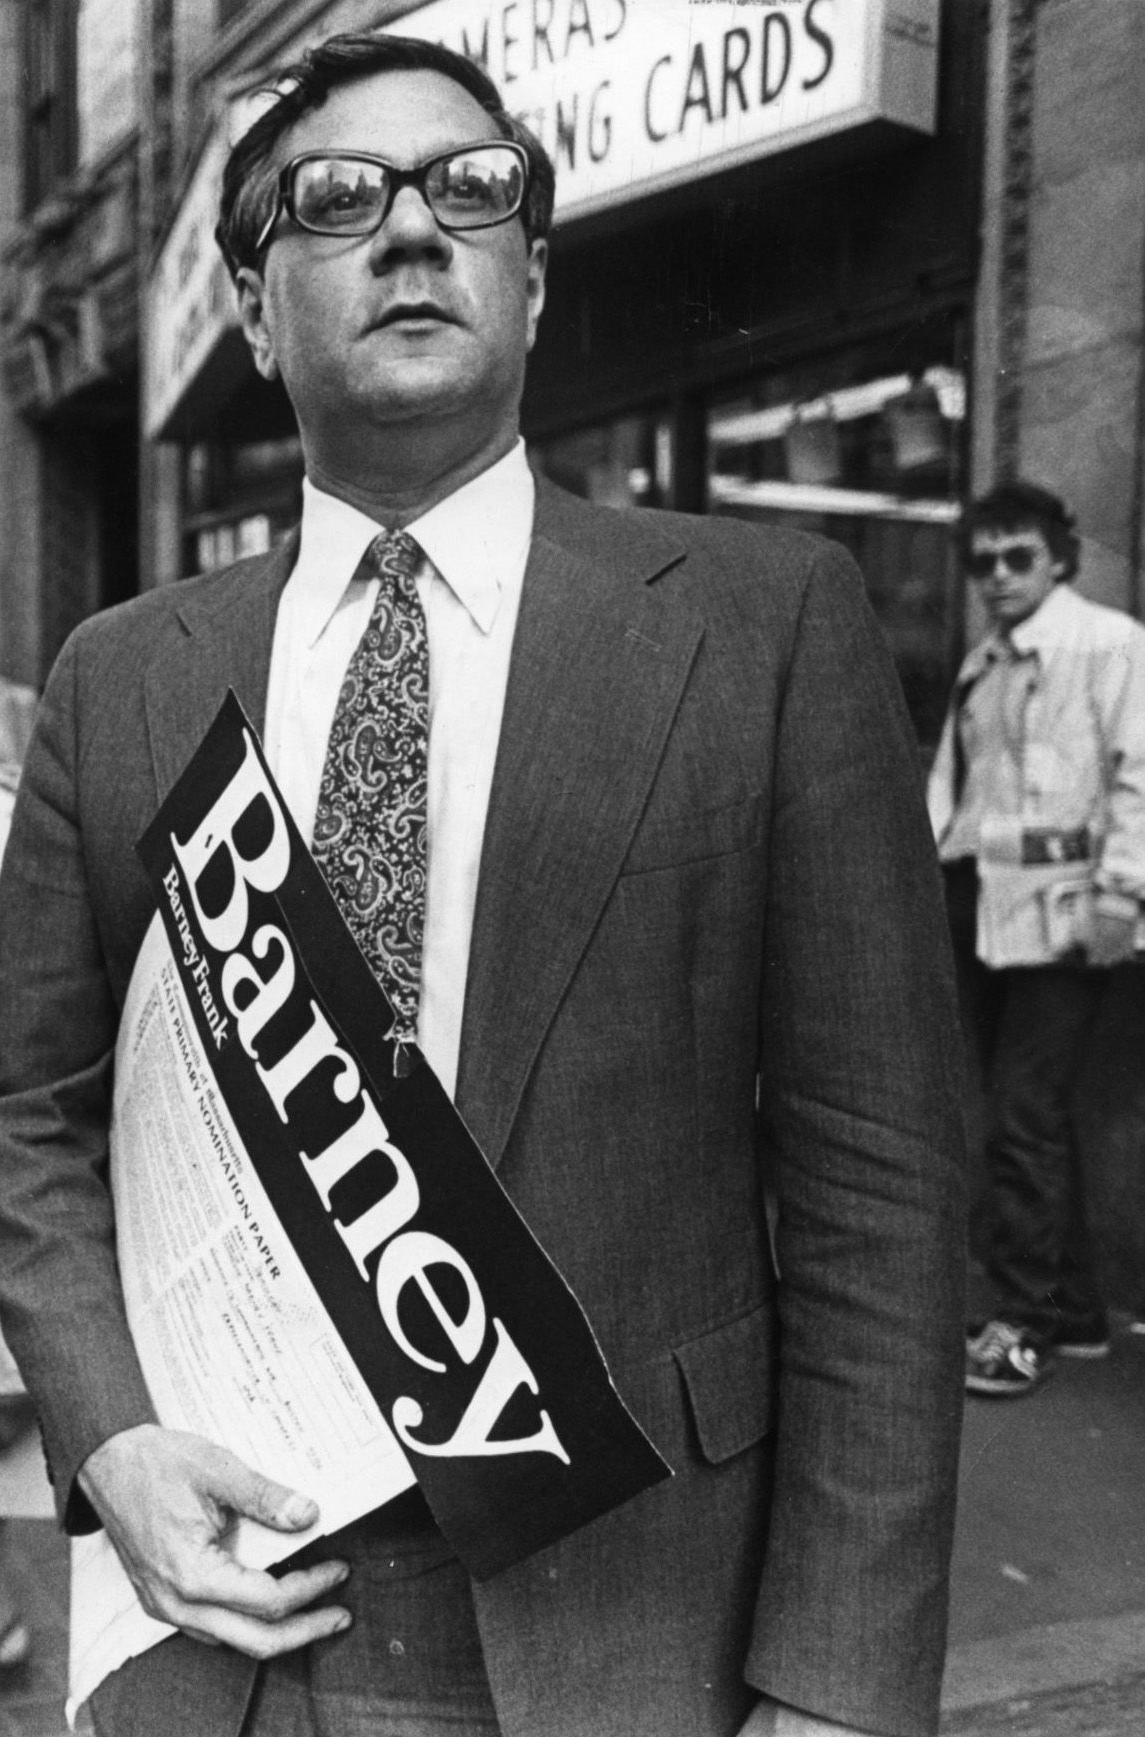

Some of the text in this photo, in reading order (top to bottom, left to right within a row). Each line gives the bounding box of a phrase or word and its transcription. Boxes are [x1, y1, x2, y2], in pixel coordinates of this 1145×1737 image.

[645, 0, 834, 143] CARDS
[160, 966, 176, 1014] STATE
[172, 1018, 201, 1092] PRIMARY
[197, 1095, 252, 1220] NOMINATION
[249, 1221, 281, 1281] PAPER
[169, 726, 571, 1466] Barney
